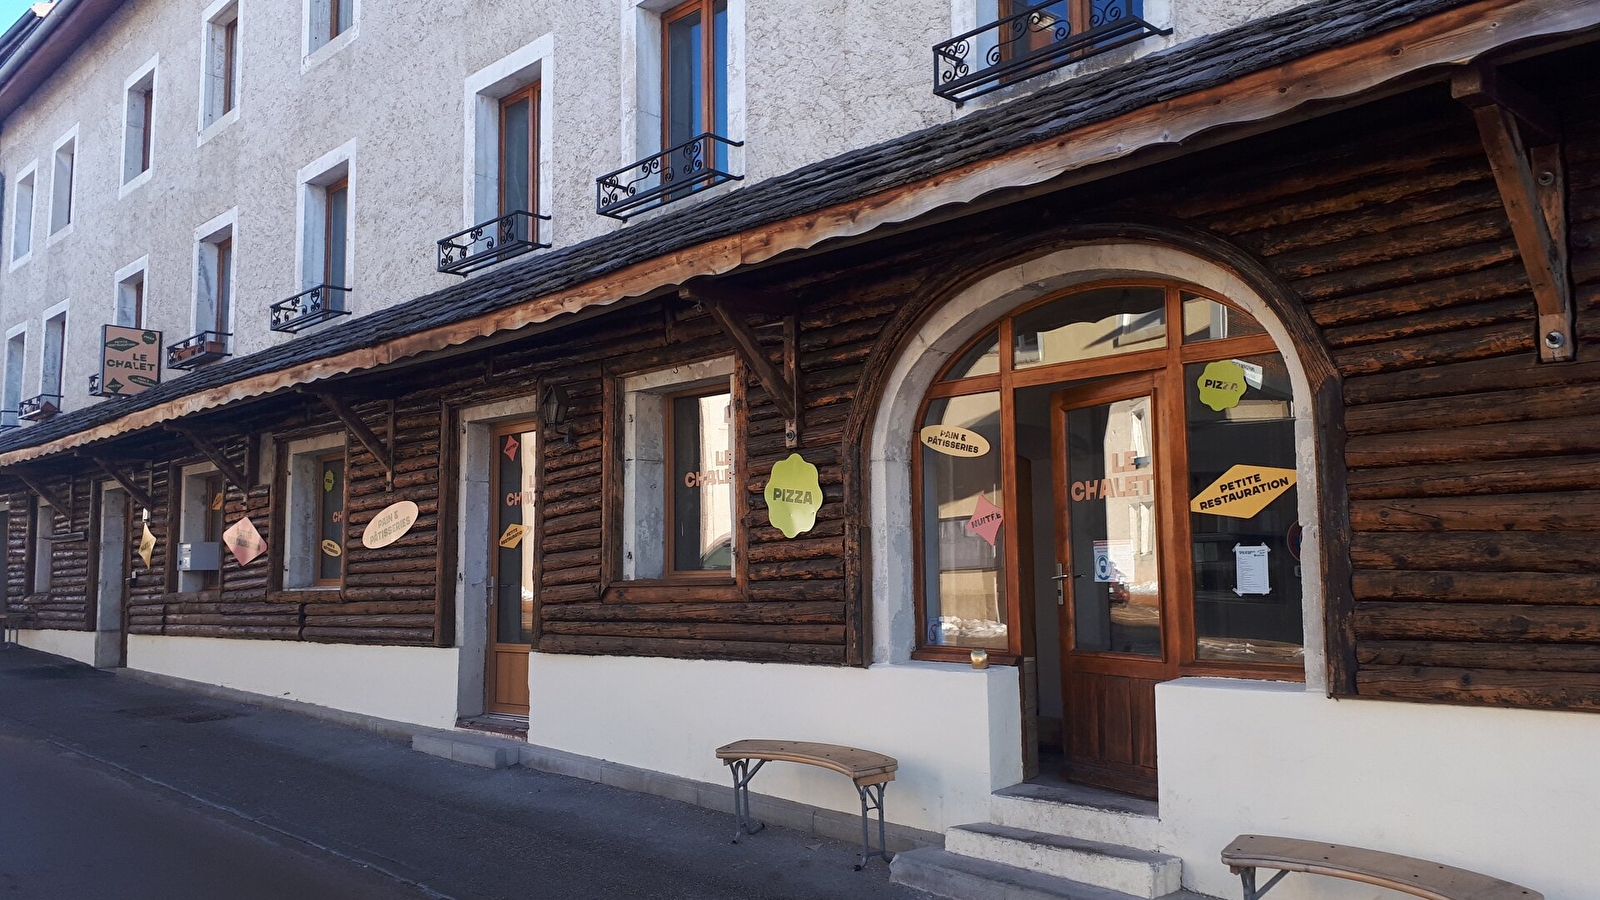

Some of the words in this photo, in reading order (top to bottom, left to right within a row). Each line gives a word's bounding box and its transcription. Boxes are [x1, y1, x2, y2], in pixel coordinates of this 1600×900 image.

[106, 359, 156, 372] CHALET
[133, 353, 147, 362] LE
[1204, 379, 1238, 392] PIZZA
[927, 436, 979, 454] PÂTISSERIES
[940, 430, 960, 440] PAIN
[961, 433, 967, 442] &
[1112, 451, 1138, 473] LE
[1071, 474, 1153, 501] CHALET
[1220, 473, 1262, 493] PETITE
[773, 487, 813, 505] PIZZA
[1199, 476, 1289, 511] RESTAURATION
[378, 513, 393, 529] PAIN
[370, 516, 411, 546] PÂTISSERIES
